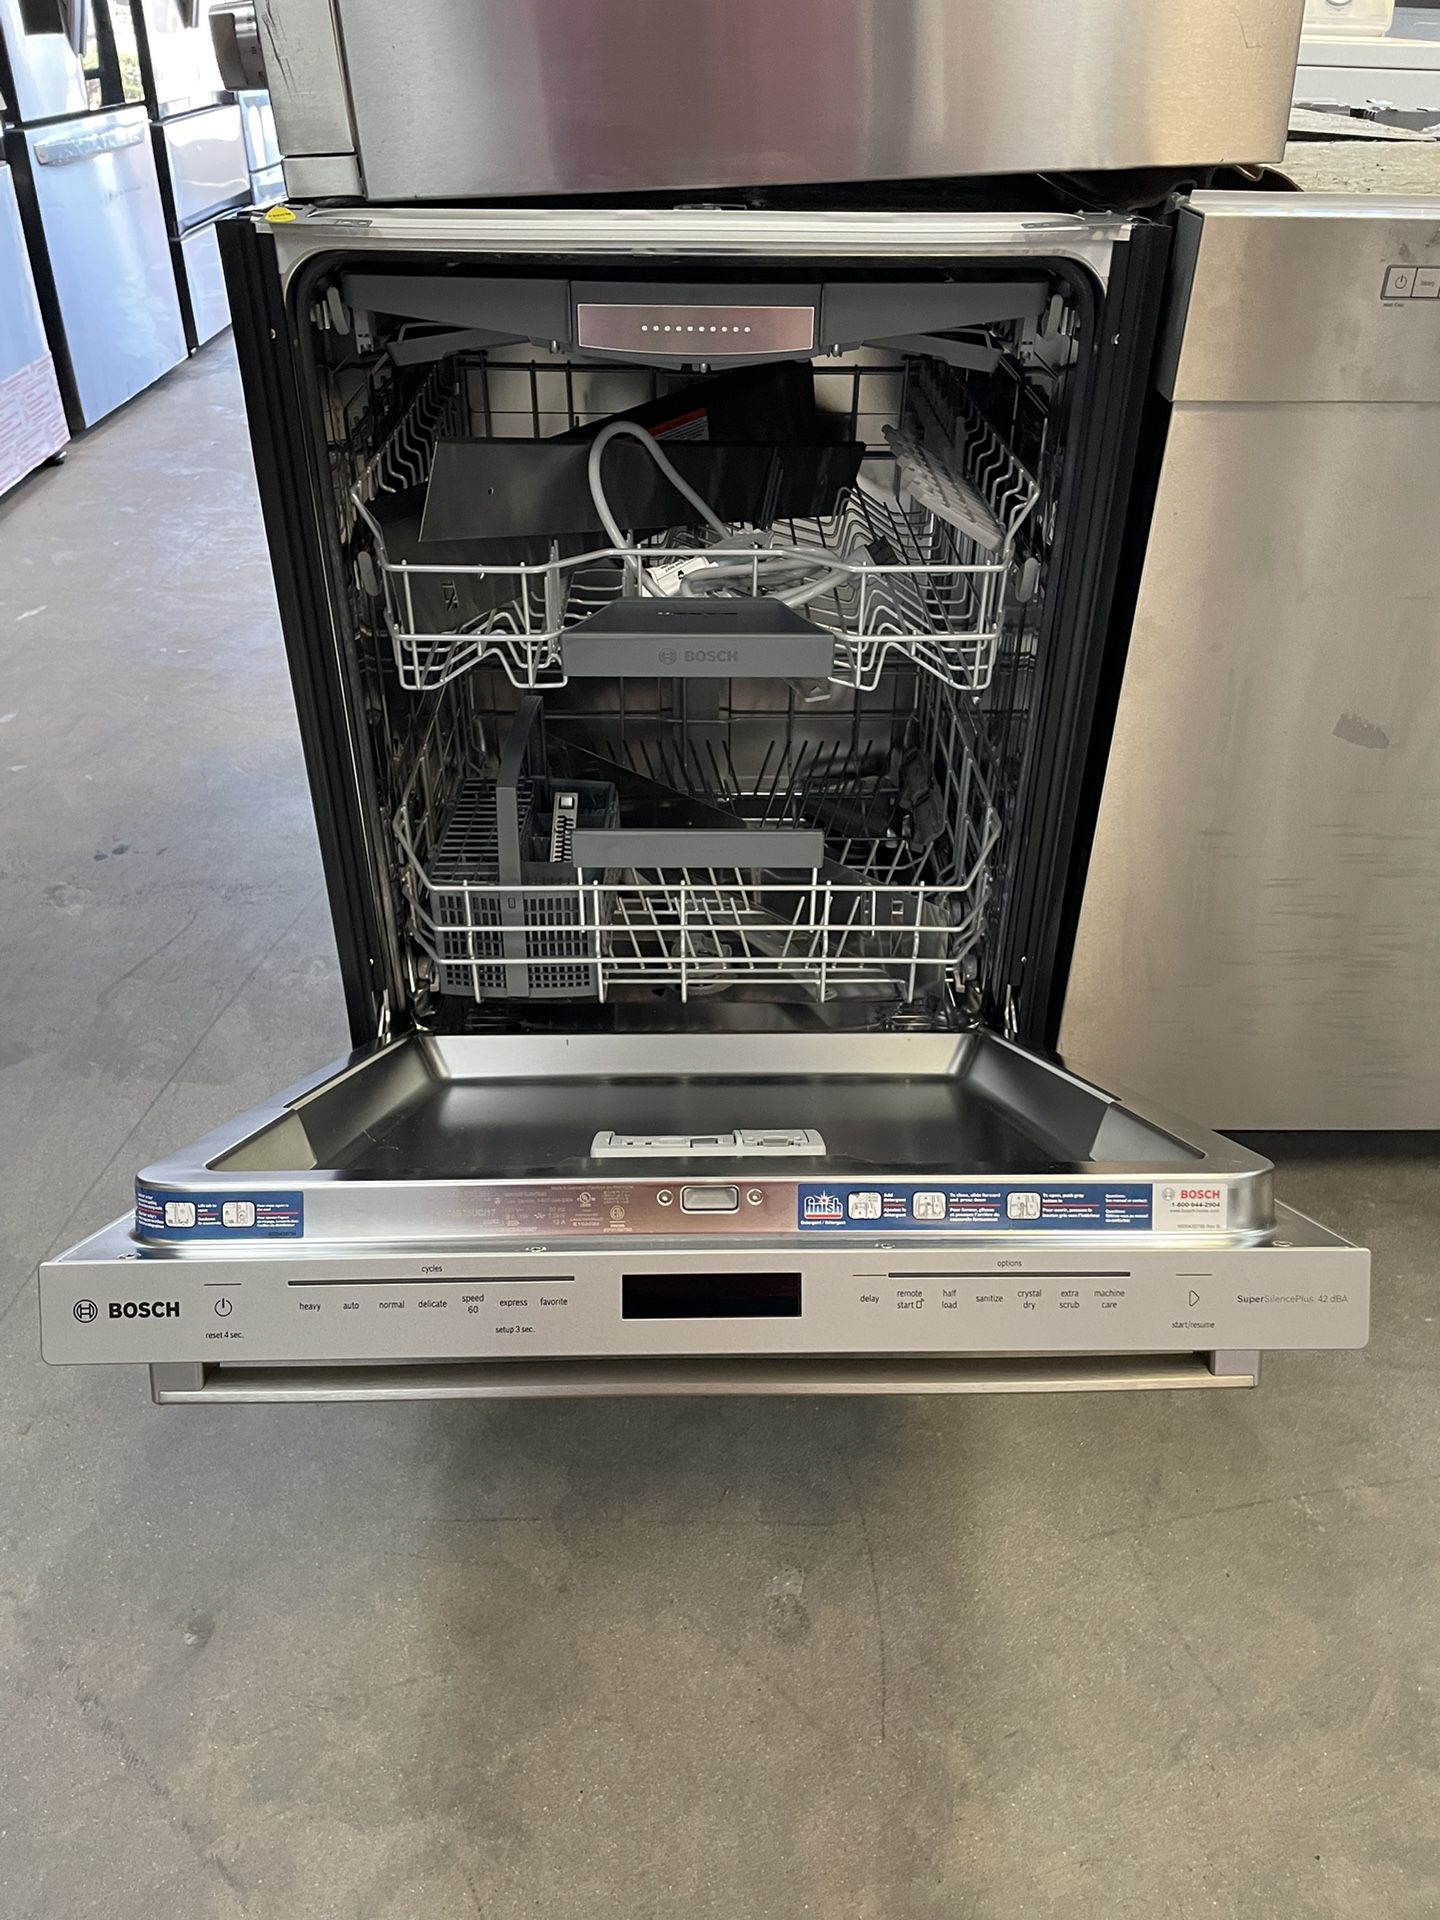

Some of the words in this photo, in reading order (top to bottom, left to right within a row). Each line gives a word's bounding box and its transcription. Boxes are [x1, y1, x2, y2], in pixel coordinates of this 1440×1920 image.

[684, 650, 738, 662] BOSCH
[1181, 1190, 1220, 1199] BOSCH
[803, 1195, 844, 1214] finish
[996, 1259, 1023, 1268] options
[421, 1264, 443, 1274] cycles
[896, 1289, 923, 1298] remote
[942, 1289, 957, 1297] half
[1017, 1289, 1042, 1298] crystal
[1060, 1289, 1079, 1298] extra
[1093, 1289, 1126, 1298] machine
[462, 1293, 485, 1304] speed
[540, 1296, 568, 1306] favorite
[859, 1294, 880, 1304] delay
[975, 1294, 1004, 1303] sanitize
[1237, 1294, 1314, 1305] SuperSilencePlus
[1318, 1294, 1328, 1304] 42
[1329, 1294, 1349, 1303] dBA
[299, 1301, 321, 1312] heavy
[342, 1301, 360, 1310] auto
[378, 1300, 405, 1309] normal
[418, 1299, 448, 1309] delicate
[499, 1299, 528, 1308] express
[896, 1300, 915, 1309] start
[941, 1301, 958, 1309] load
[1023, 1301, 1036, 1310] dry
[1059, 1301, 1080, 1309] scrub
[1101, 1301, 1118, 1309] care
[108, 1301, 180, 1319] BOSCH
[467, 1305, 479, 1314] 60
[1171, 1320, 1216, 1330] start/resume
[205, 1331, 223, 1339] reset
[230, 1331, 244, 1339] sec.
[495, 1326, 515, 1335] setup
[521, 1326, 536, 1334] sec.
